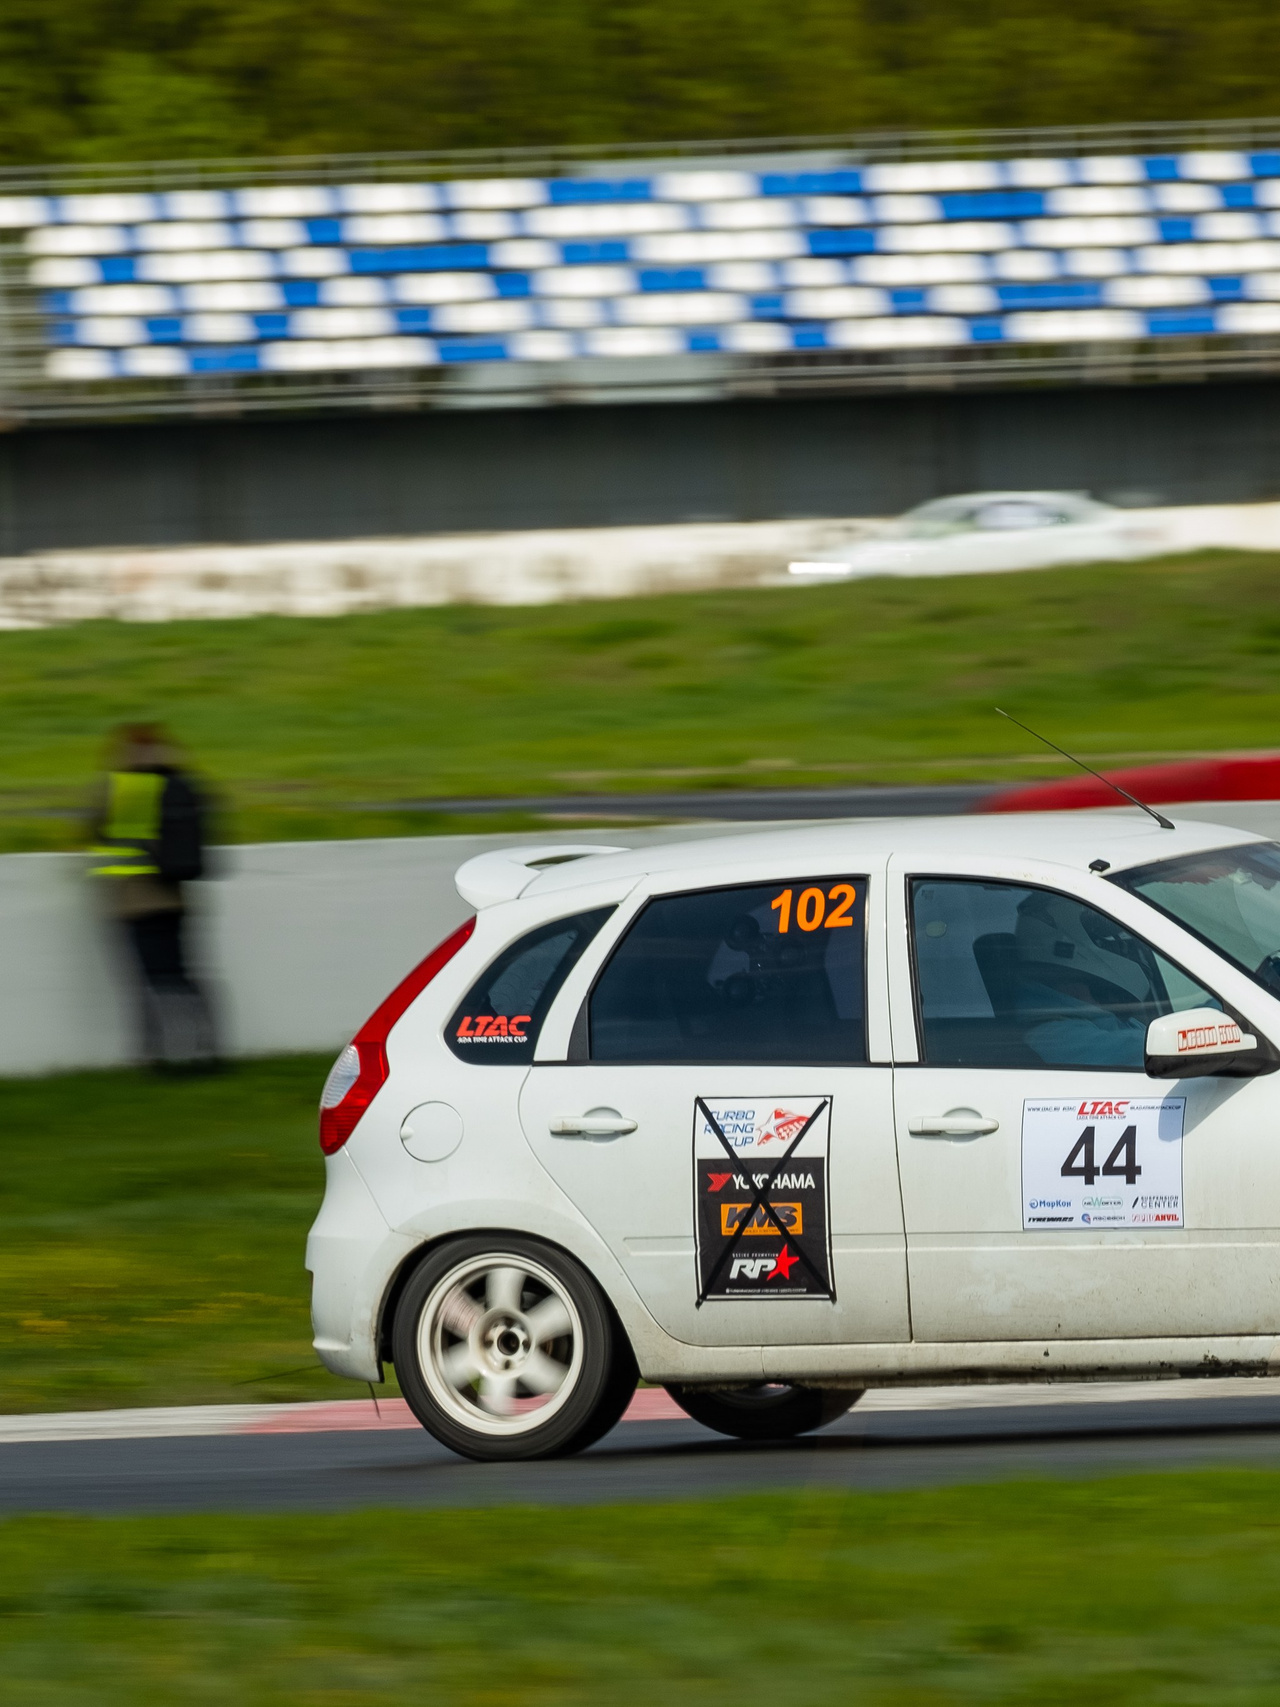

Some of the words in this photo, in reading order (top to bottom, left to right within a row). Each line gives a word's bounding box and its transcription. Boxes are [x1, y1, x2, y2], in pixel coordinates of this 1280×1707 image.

[771, 884, 856, 934] 102
[456, 1015, 532, 1036] LTAC
[1078, 1101, 1130, 1115] LTAC
[1061, 1125, 1142, 1186] 44
[729, 1259, 777, 1280] RP
